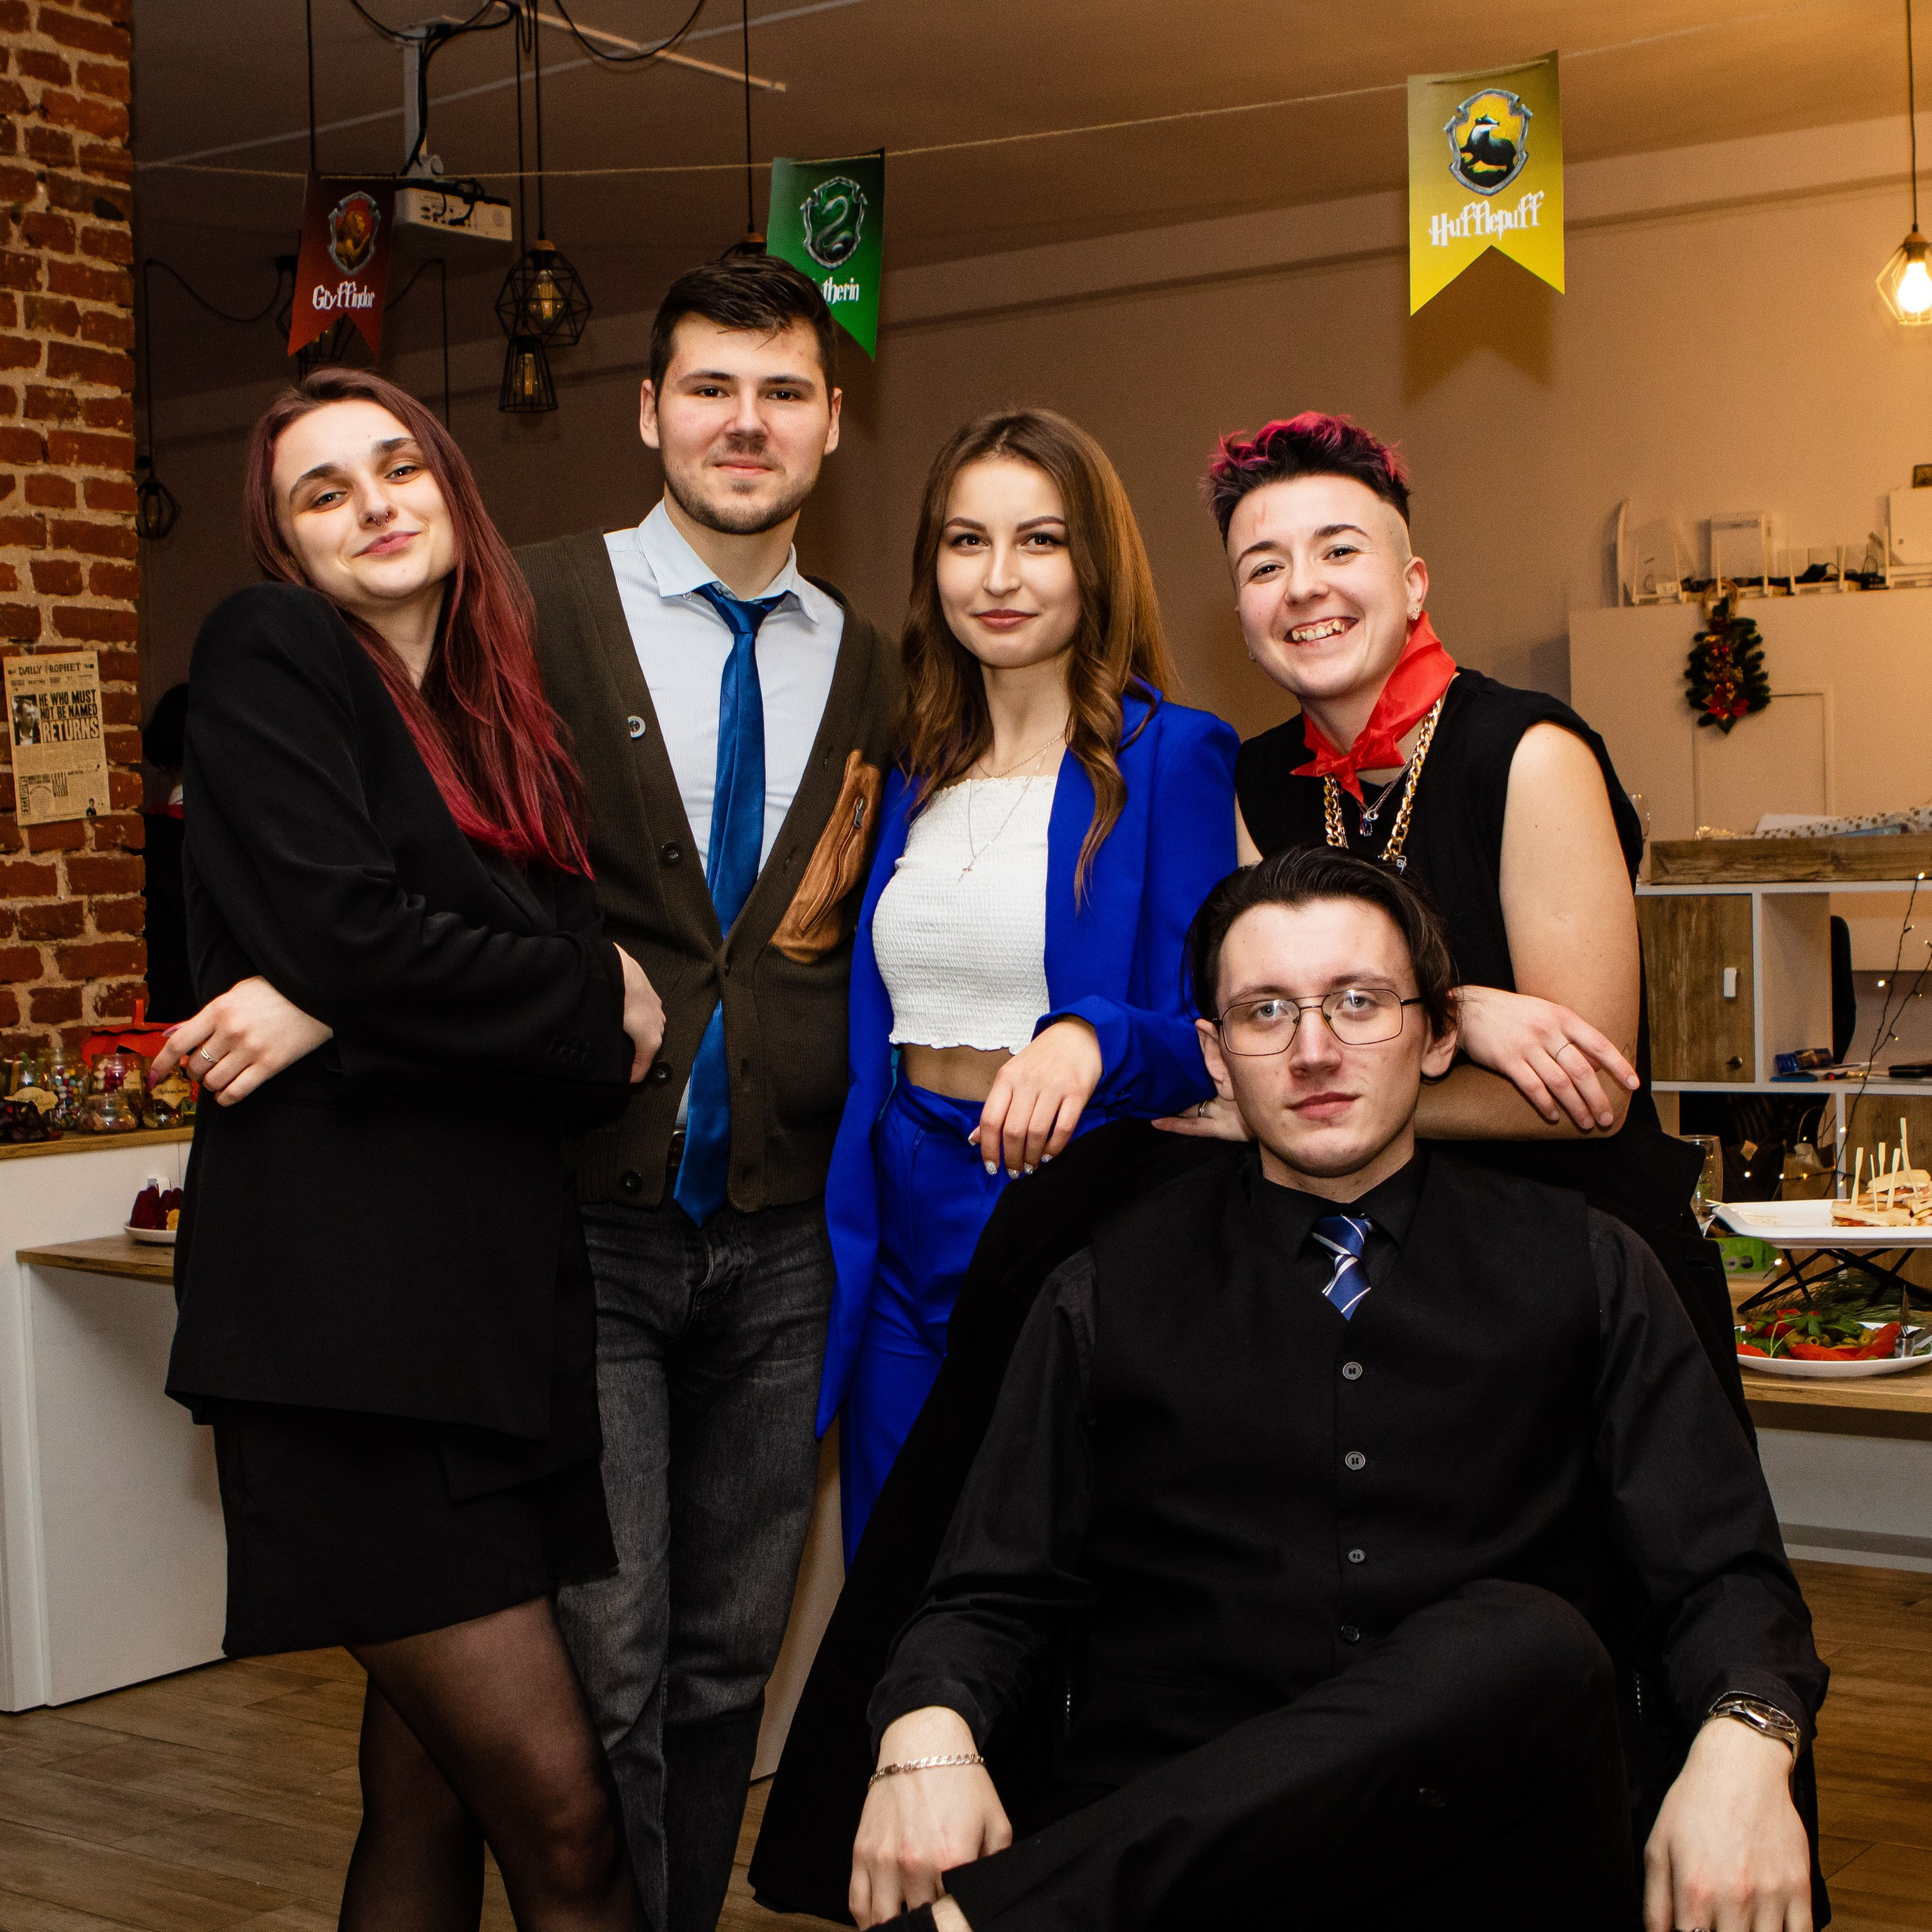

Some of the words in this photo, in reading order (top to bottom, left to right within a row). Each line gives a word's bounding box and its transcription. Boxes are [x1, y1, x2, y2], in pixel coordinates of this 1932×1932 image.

[1429, 190, 1545, 246] Hufflepuff
[312, 281, 375, 310] Gryffindor
[821, 276, 860, 305] therin
[18, 665, 42, 675] DAILY
[45, 662, 82, 673] PROPHET
[38, 693, 48, 706] HE
[50, 691, 69, 706] WHO
[71, 688, 96, 705] MUST
[40, 707, 54, 720] NOT
[57, 706, 66, 718] BE
[68, 703, 98, 718] NAMED
[42, 716, 100, 743] RETURNS
